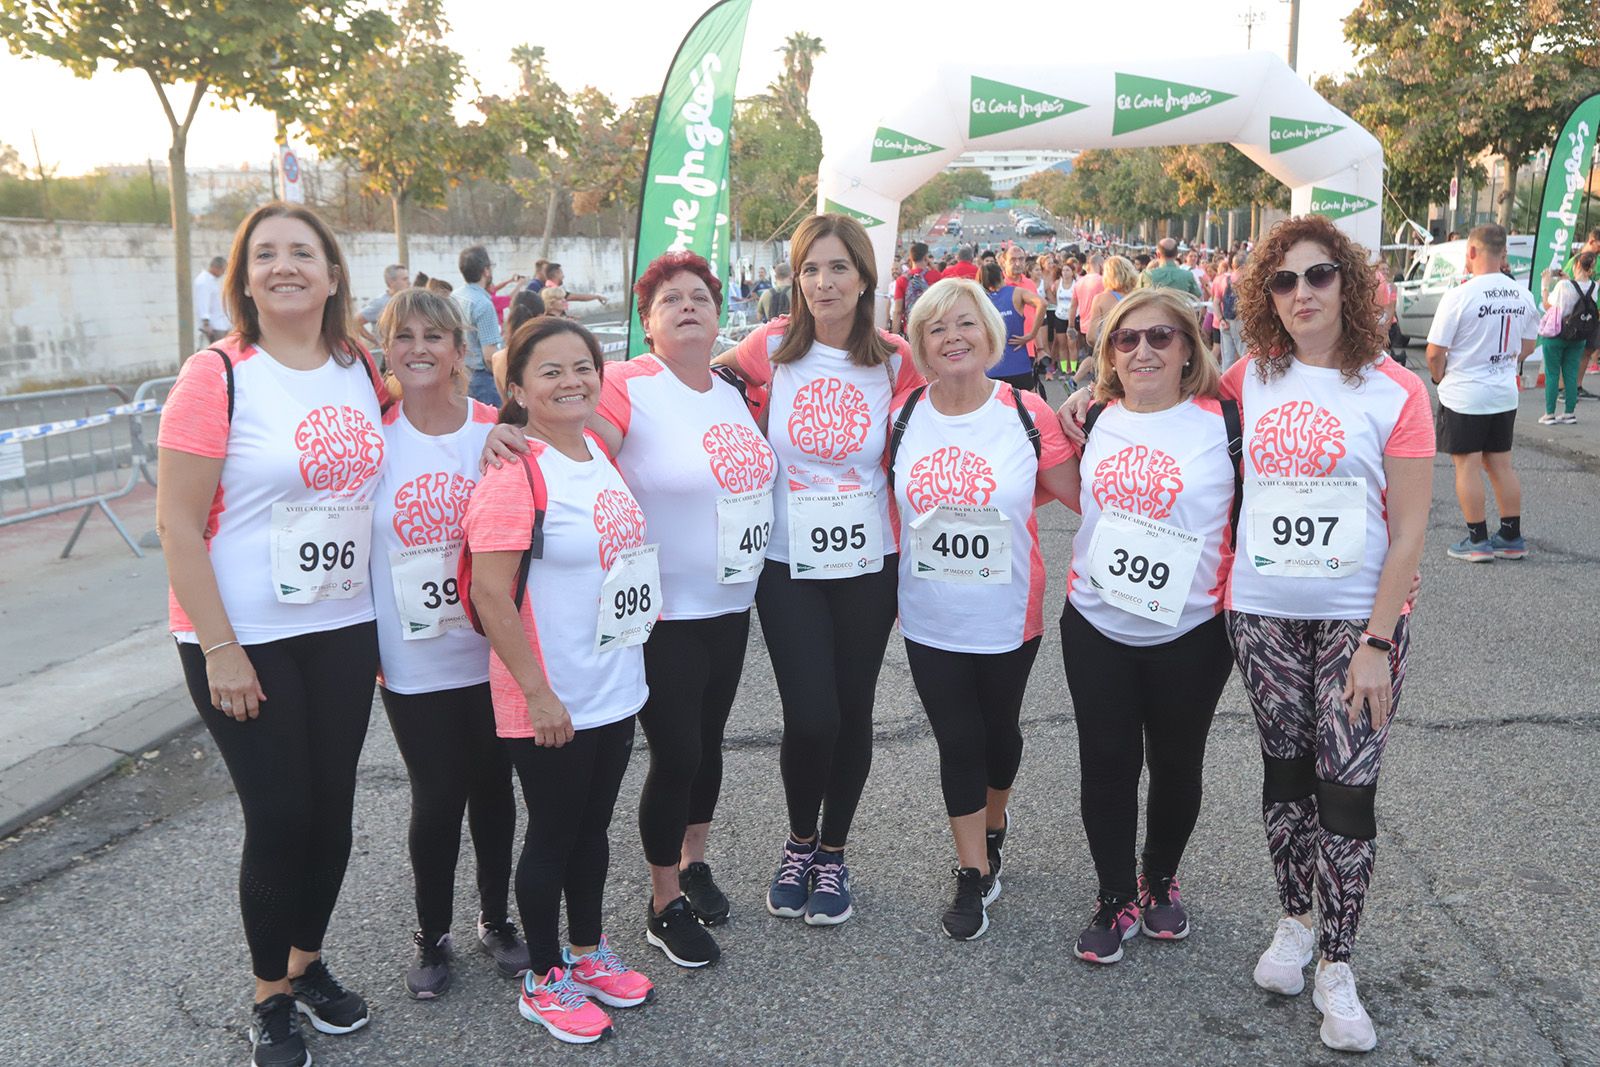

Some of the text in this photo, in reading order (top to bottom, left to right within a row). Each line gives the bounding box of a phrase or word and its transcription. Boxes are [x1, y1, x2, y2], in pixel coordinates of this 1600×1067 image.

[971, 94, 1065, 118] El Corte Inglés
[1117, 88, 1212, 112] El Corte Inglés
[654, 52, 724, 197] Inglés
[1271, 124, 1334, 140] El Corte Inglés
[1547, 120, 1589, 226] Inglés
[740, 521, 770, 554] 403
[811, 523, 866, 553] 995
[1112, 511, 1128, 521] XVIII
[1128, 516, 1157, 530] CARRERA
[1158, 526, 1167, 534] DE
[1272, 516, 1339, 546] 997
[299, 540, 355, 572] 996
[931, 532, 989, 560] 400
[1108, 548, 1170, 590] 399
[422, 577, 461, 609] 39
[614, 583, 651, 620] 998
